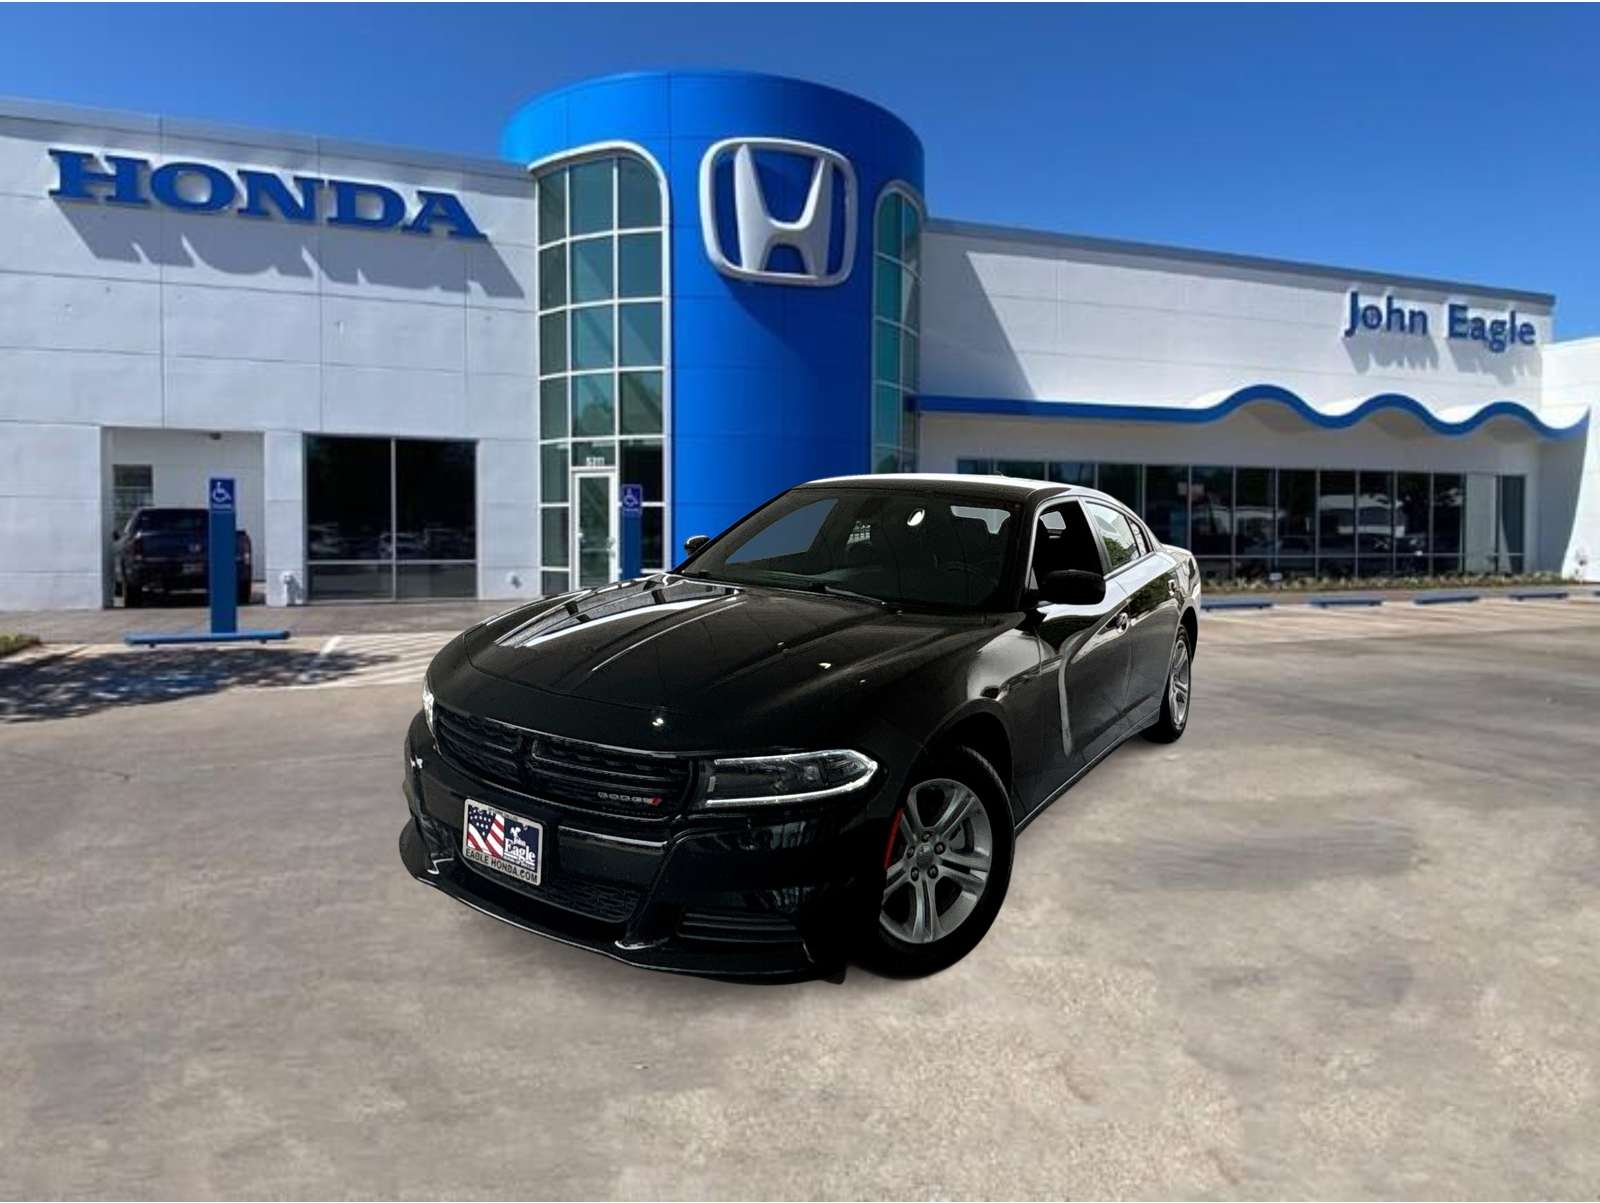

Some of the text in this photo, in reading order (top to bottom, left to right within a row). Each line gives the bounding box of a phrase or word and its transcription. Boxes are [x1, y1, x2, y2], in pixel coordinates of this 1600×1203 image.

[49, 148, 488, 240] HONDA
[1344, 291, 1536, 353] John Eagle
[465, 848, 489, 864] EAGLE
[491, 858, 538, 883] HONDA.COM
[504, 838, 536, 864] Eagle
